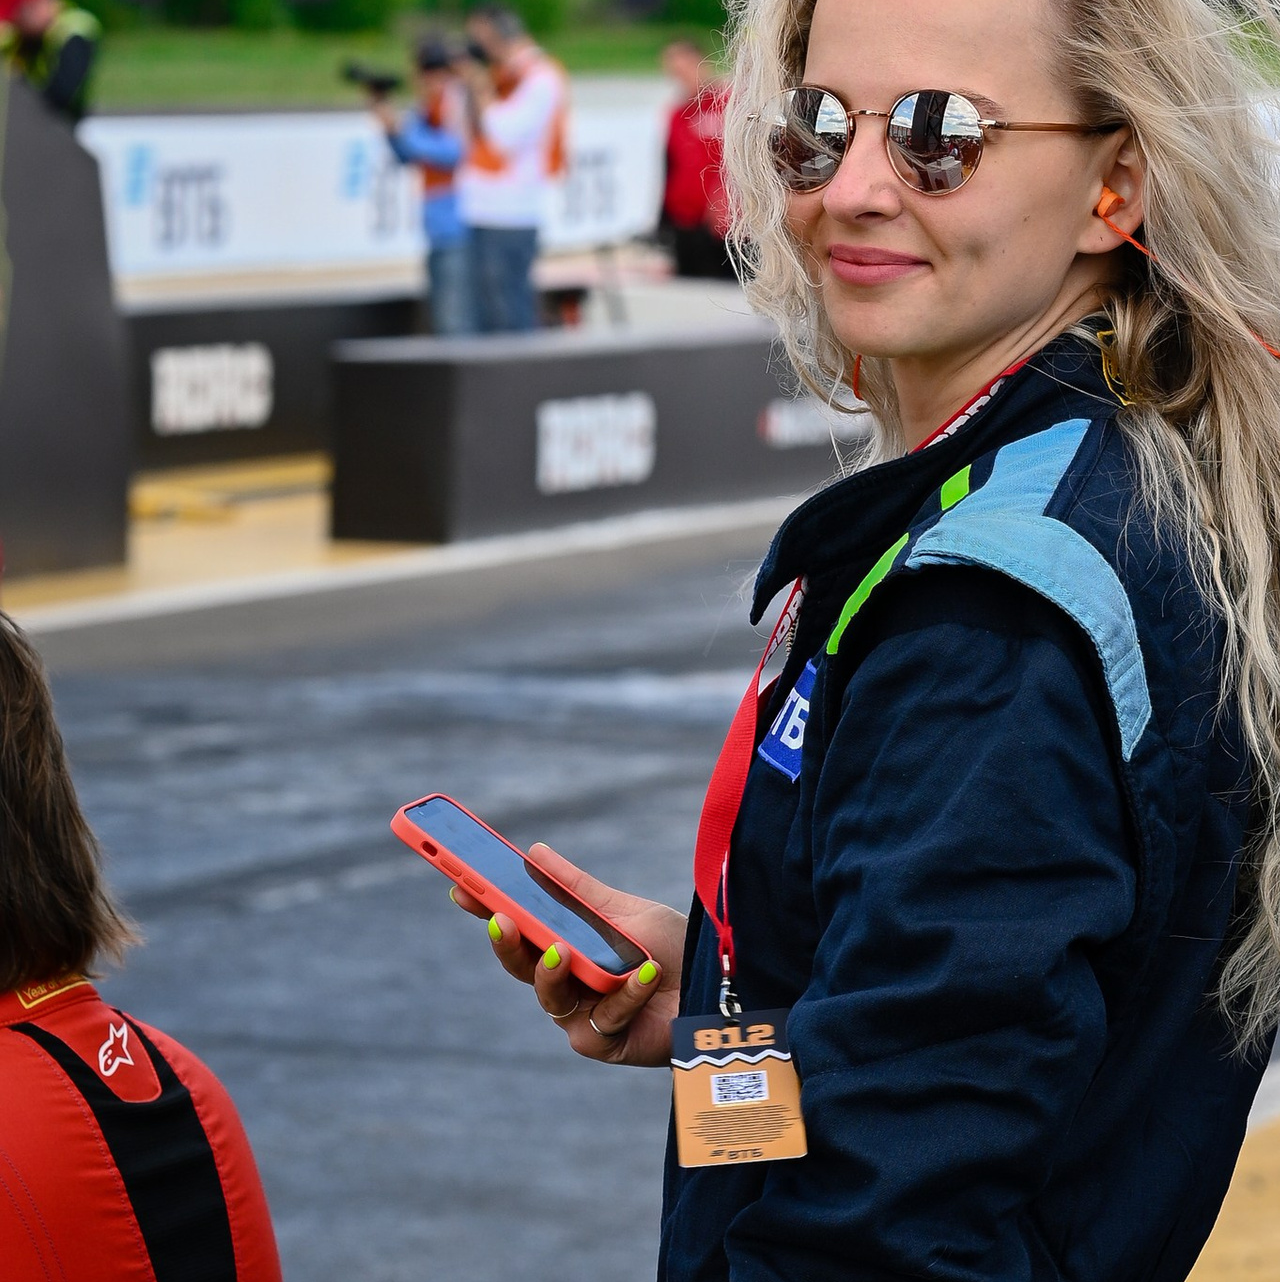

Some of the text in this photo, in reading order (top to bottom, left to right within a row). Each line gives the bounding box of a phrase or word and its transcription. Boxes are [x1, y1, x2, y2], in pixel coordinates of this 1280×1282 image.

[770, 687, 810, 749] ТБ
[24, 985, 47, 1000] Year
[695, 1024, 774, 1051] 812
